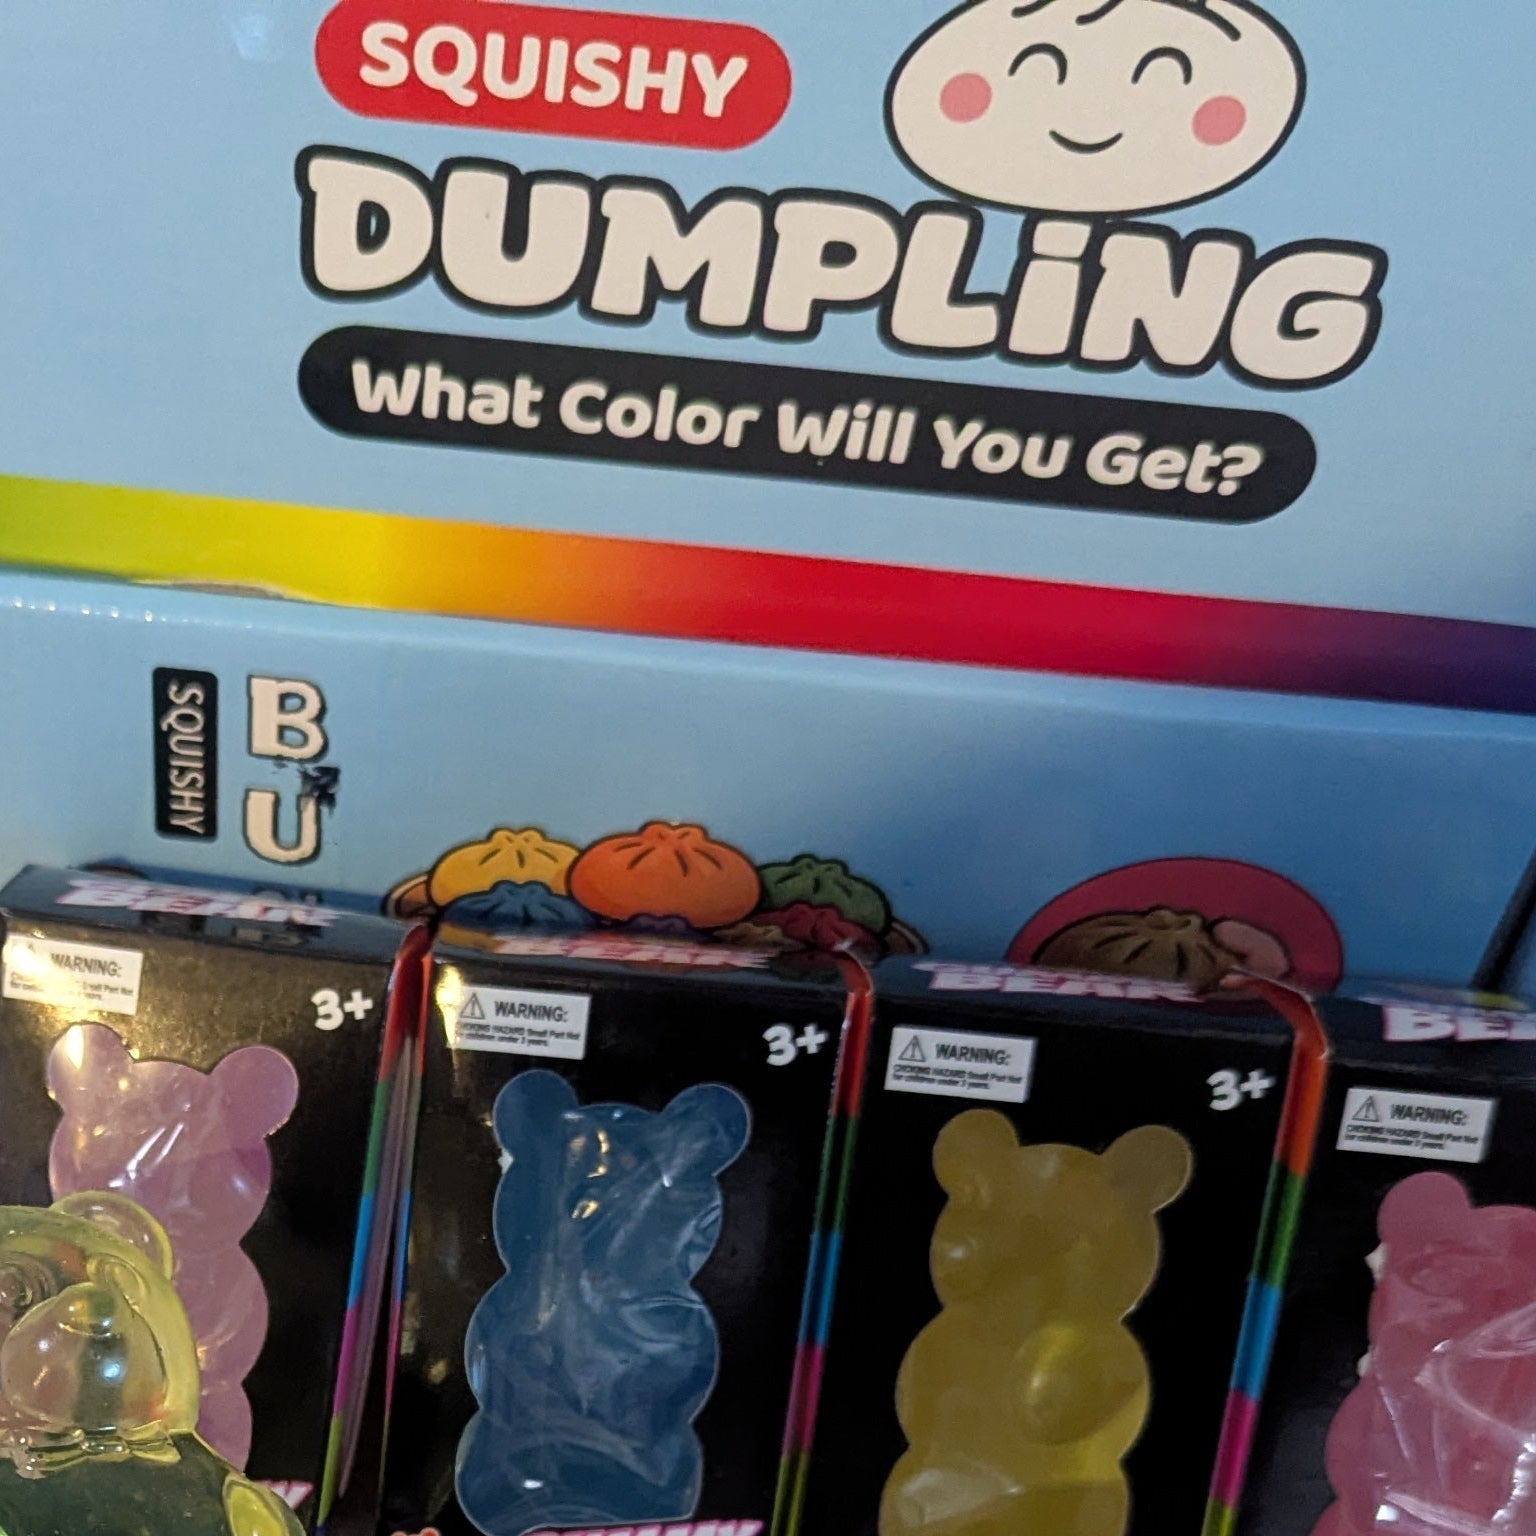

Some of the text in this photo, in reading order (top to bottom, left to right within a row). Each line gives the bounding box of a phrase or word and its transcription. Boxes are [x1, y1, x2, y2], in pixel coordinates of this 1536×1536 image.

[358, 22, 747, 119] SQUISHY
[350, 360, 1262, 498] What Color Will You Get?
[161, 680, 205, 834] SQUISHY
[51, 953, 123, 977] WARNING:
[311, 987, 374, 1031] 3+
[494, 1001, 568, 1022] WARNING:
[763, 1021, 829, 1067] 3+
[936, 1043, 1011, 1065] WARNING:
[1205, 1068, 1276, 1111] 3+
[1391, 1103, 1467, 1126] WARNING:
